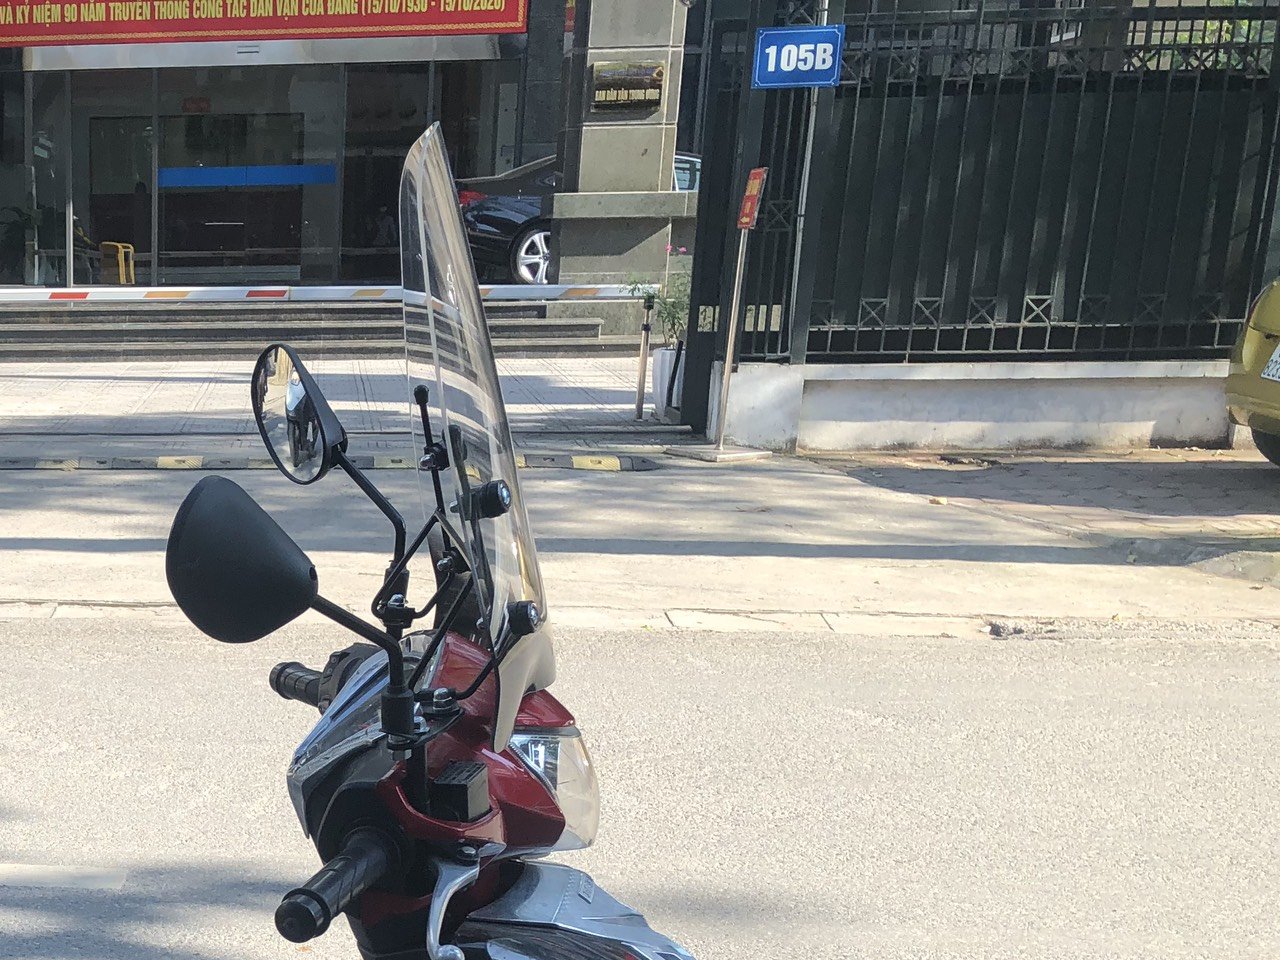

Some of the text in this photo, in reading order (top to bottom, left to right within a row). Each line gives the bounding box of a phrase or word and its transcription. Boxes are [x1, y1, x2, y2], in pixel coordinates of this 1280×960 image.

[0, 2, 14, 24] VÀ
[33, 1, 62, 27] NIỆM
[64, 4, 78, 22] 90
[765, 43, 833, 72] 105B
